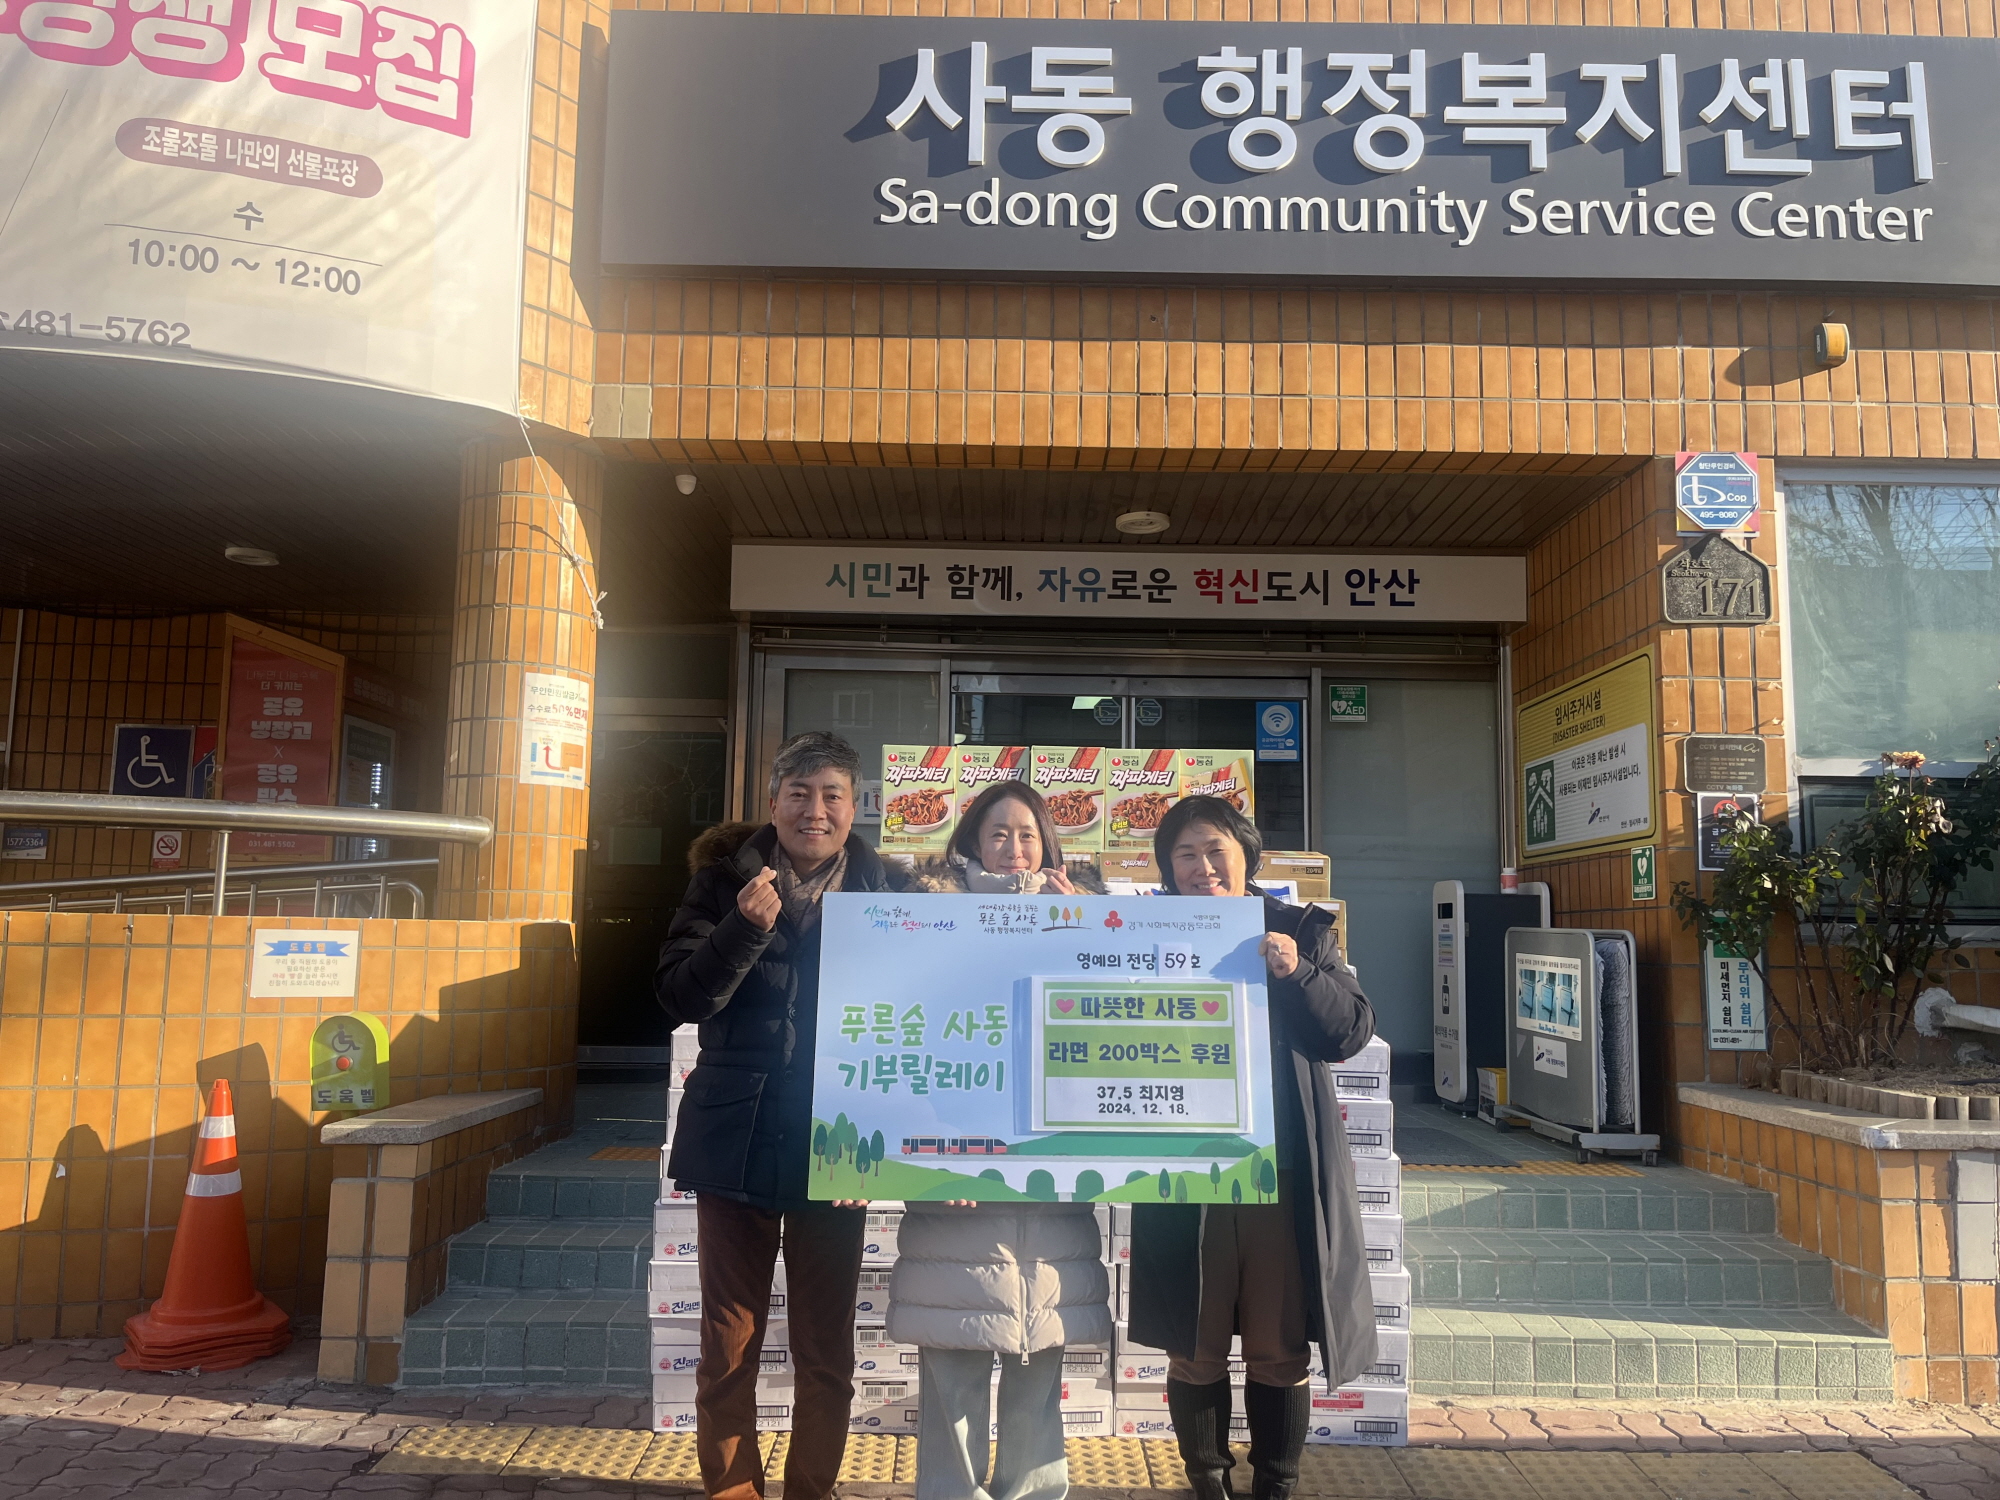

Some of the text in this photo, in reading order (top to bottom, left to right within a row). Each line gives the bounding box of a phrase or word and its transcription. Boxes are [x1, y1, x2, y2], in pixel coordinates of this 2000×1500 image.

[258, 0, 475, 130] 모집
[886, 42, 1933, 183] 사동 행정복지센터
[142, 125, 358, 187] 조물조물 나만의 선물포장
[233, 201, 264, 231] 수
[879, 178, 1933, 246] Sa-dong Community Service Center
[128, 238, 219, 274] 10:00
[275, 258, 361, 296] 12:00
[1700, 511, 1738, 519] 495-8080
[825, 562, 1420, 607] 시민과 함께, 자유로운 혁신도시 안산
[1698, 578, 1765, 616] 171
[261, 681, 303, 691] 더 커지는
[531, 686, 581, 700] 무인민원발급기
[263, 697, 304, 717] 공유
[1345, 706, 1365, 715] AED
[1555, 688, 1601, 727] 임시주거시설
[251, 720, 313, 740] 냉장고
[1553, 713, 1605, 746] (DISASTER SHELTER)
[274, 746, 284, 758] X
[899, 753, 916, 762] 농심
[973, 753, 990, 763] 농심
[1048, 756, 1064, 764] 농심
[1122, 758, 1139, 766] 농심
[1196, 758, 1213, 766] 농심
[1572, 757, 1585, 770] 이곳은
[1587, 752, 1596, 766] 각종
[1609, 744, 1619, 760] 발생
[1621, 742, 1626, 756] 시
[257, 764, 298, 784] 공유
[885, 764, 951, 787] 짜파게티
[959, 765, 1025, 787] 짜파게티
[1034, 766, 1100, 788] 짜파게티
[1109, 769, 1177, 790] 짜파게티
[1559, 763, 1641, 796] 사용되는 이재민 임시주거시설입니다.
[7, 838, 44, 847] 1577-5364
[248, 840, 296, 848] 031.481.5502
[934, 920, 957, 931] 안산
[979, 912, 1038, 926] 푸른 숲 사동
[1128, 921, 1221, 931] 경기 사회복지공동모금회
[1077, 952, 1121, 970] 영예의
[1126, 953, 1156, 970] 전당
[1720, 961, 1732, 1027] 미세먼지 쉼터
[1738, 961, 1752, 1027] 무더위 쉼터
[1081, 997, 1197, 1019] 따뜻한 사동
[840, 1002, 1009, 1047] 푸른숲 사동
[1048, 1042, 1231, 1064] 라면 200박스 후원
[837, 1053, 1004, 1095] 기부릴레이
[1097, 1085, 1184, 1101] 37.5 최지영
[1098, 1103, 1189, 1116] 2024. 12. 18.
[672, 1300, 700, 1314] 진라면
[1137, 1366, 1166, 1380] 진라면
[1136, 1421, 1164, 1434] 진라면
